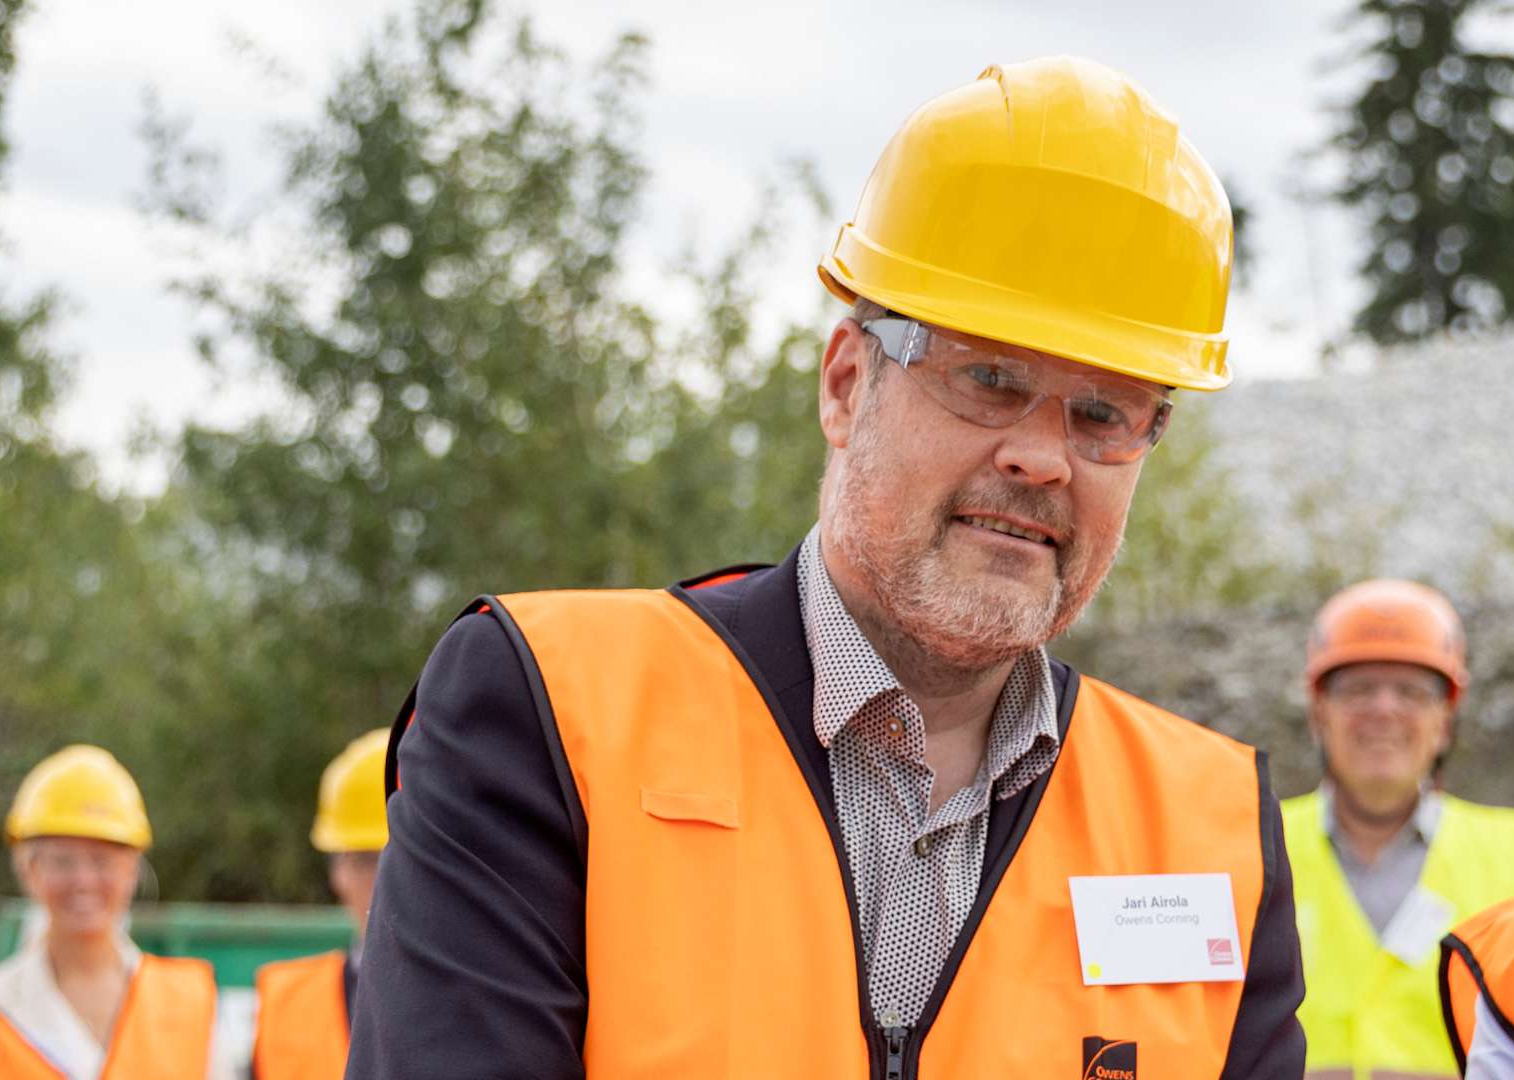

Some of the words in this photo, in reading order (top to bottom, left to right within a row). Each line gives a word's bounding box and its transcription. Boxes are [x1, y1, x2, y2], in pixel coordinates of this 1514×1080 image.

[1122, 896, 1147, 909] Jari
[1150, 895, 1189, 908] Airola
[1114, 914, 1153, 926] Owens
[1156, 913, 1200, 925] Corning
[1096, 1065, 1134, 1080] OWENS
